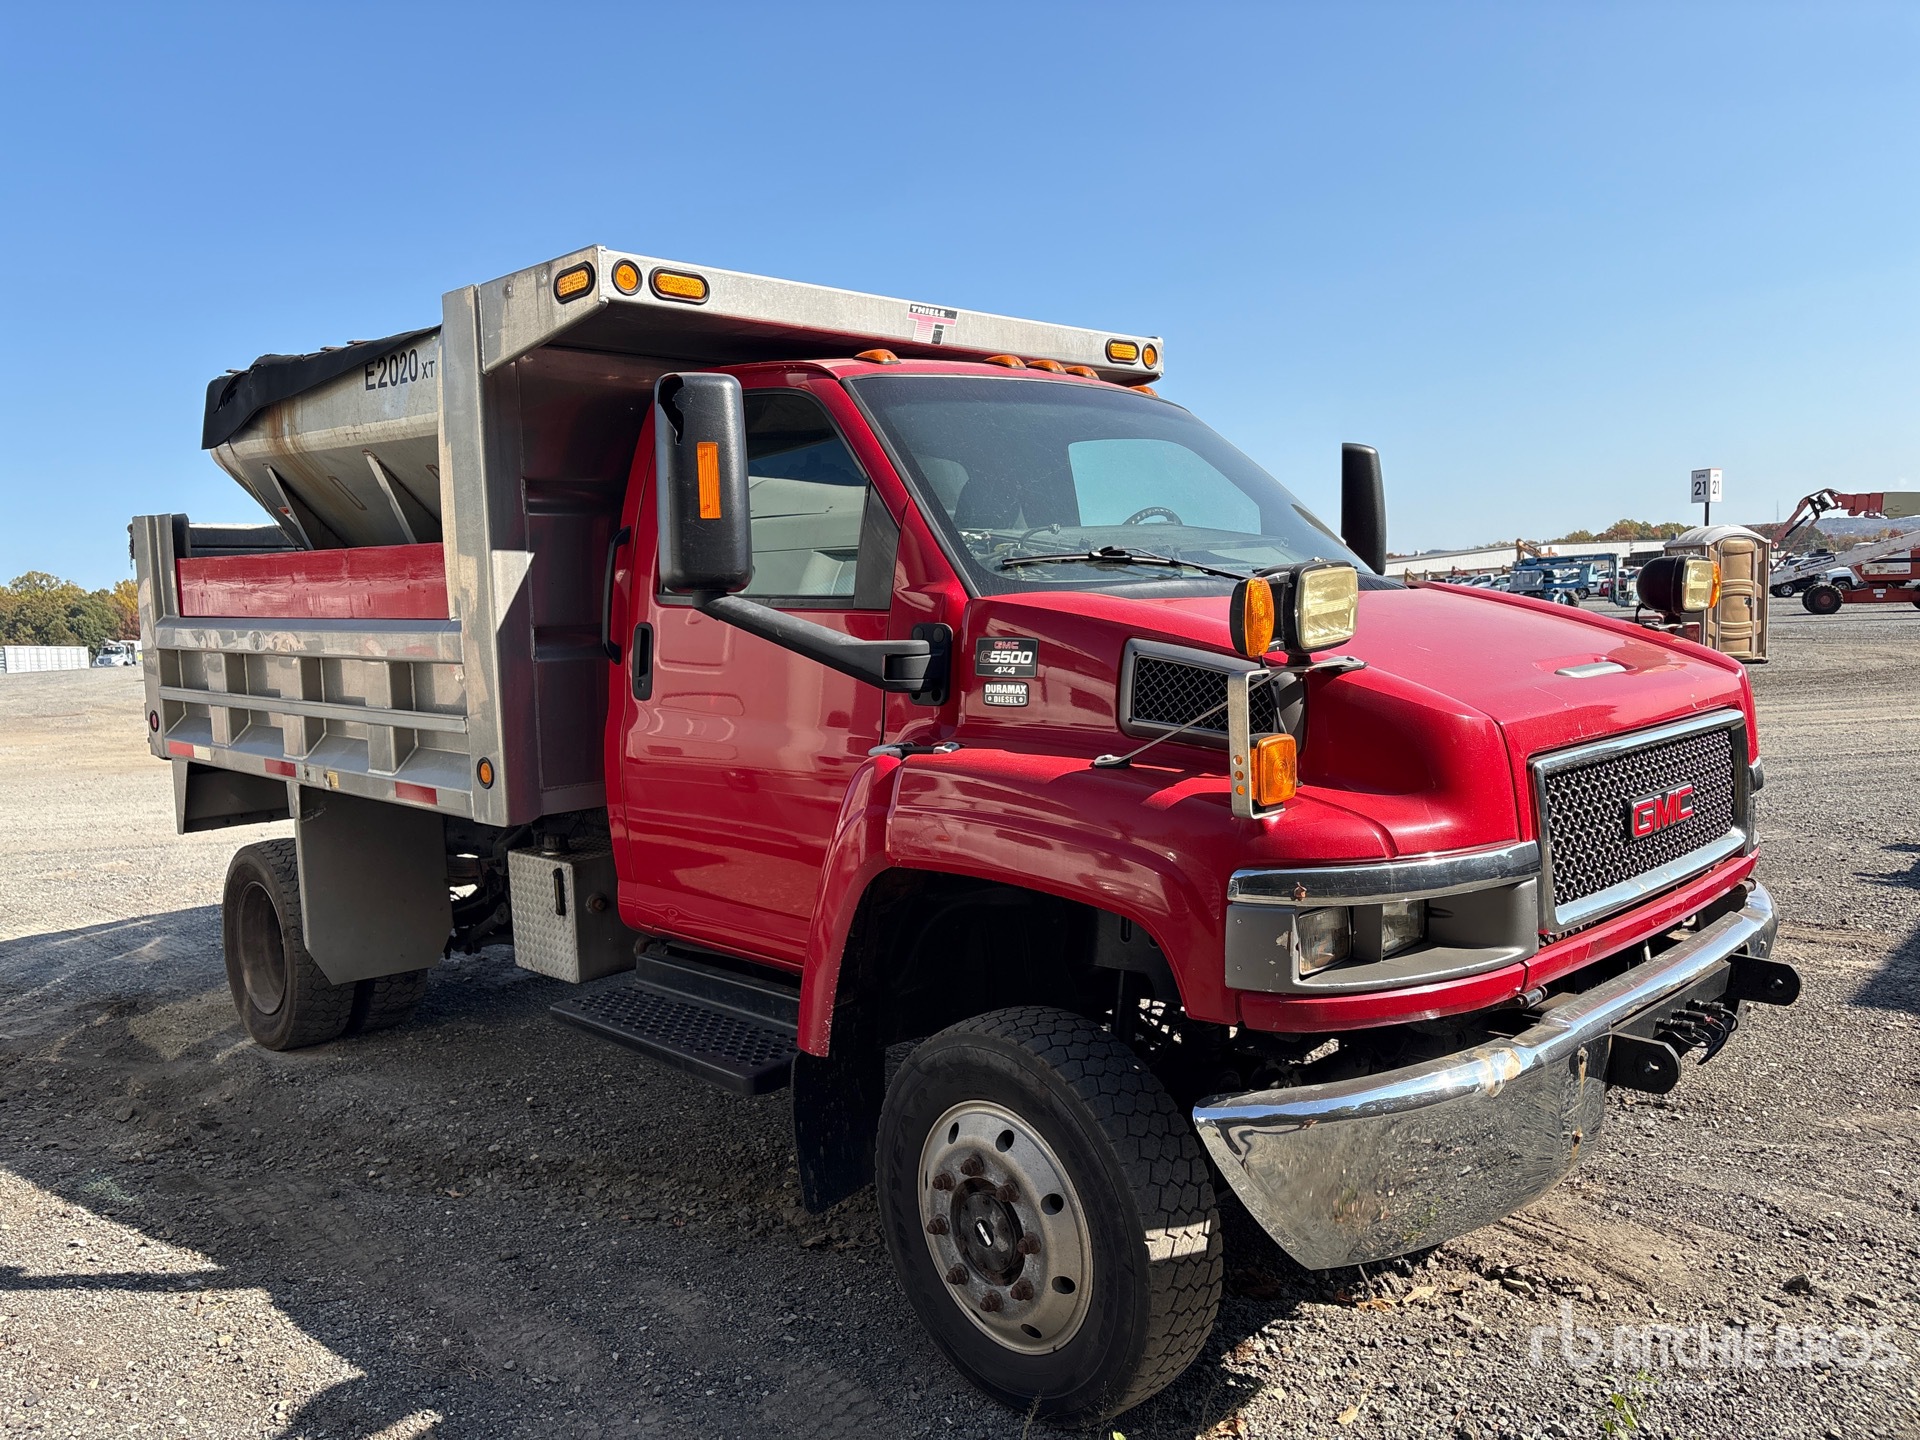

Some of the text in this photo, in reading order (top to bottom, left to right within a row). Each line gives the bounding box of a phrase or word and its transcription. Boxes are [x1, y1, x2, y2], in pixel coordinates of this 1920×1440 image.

[365, 348, 435, 391] E2020 XT
[1694, 480, 1707, 496] 21
[1712, 480, 1720, 495] 21
[994, 641, 1019, 649] GMC
[980, 651, 1033, 664] C5500
[985, 684, 1027, 695] DURAMAX
[1631, 784, 1694, 838] GMC
